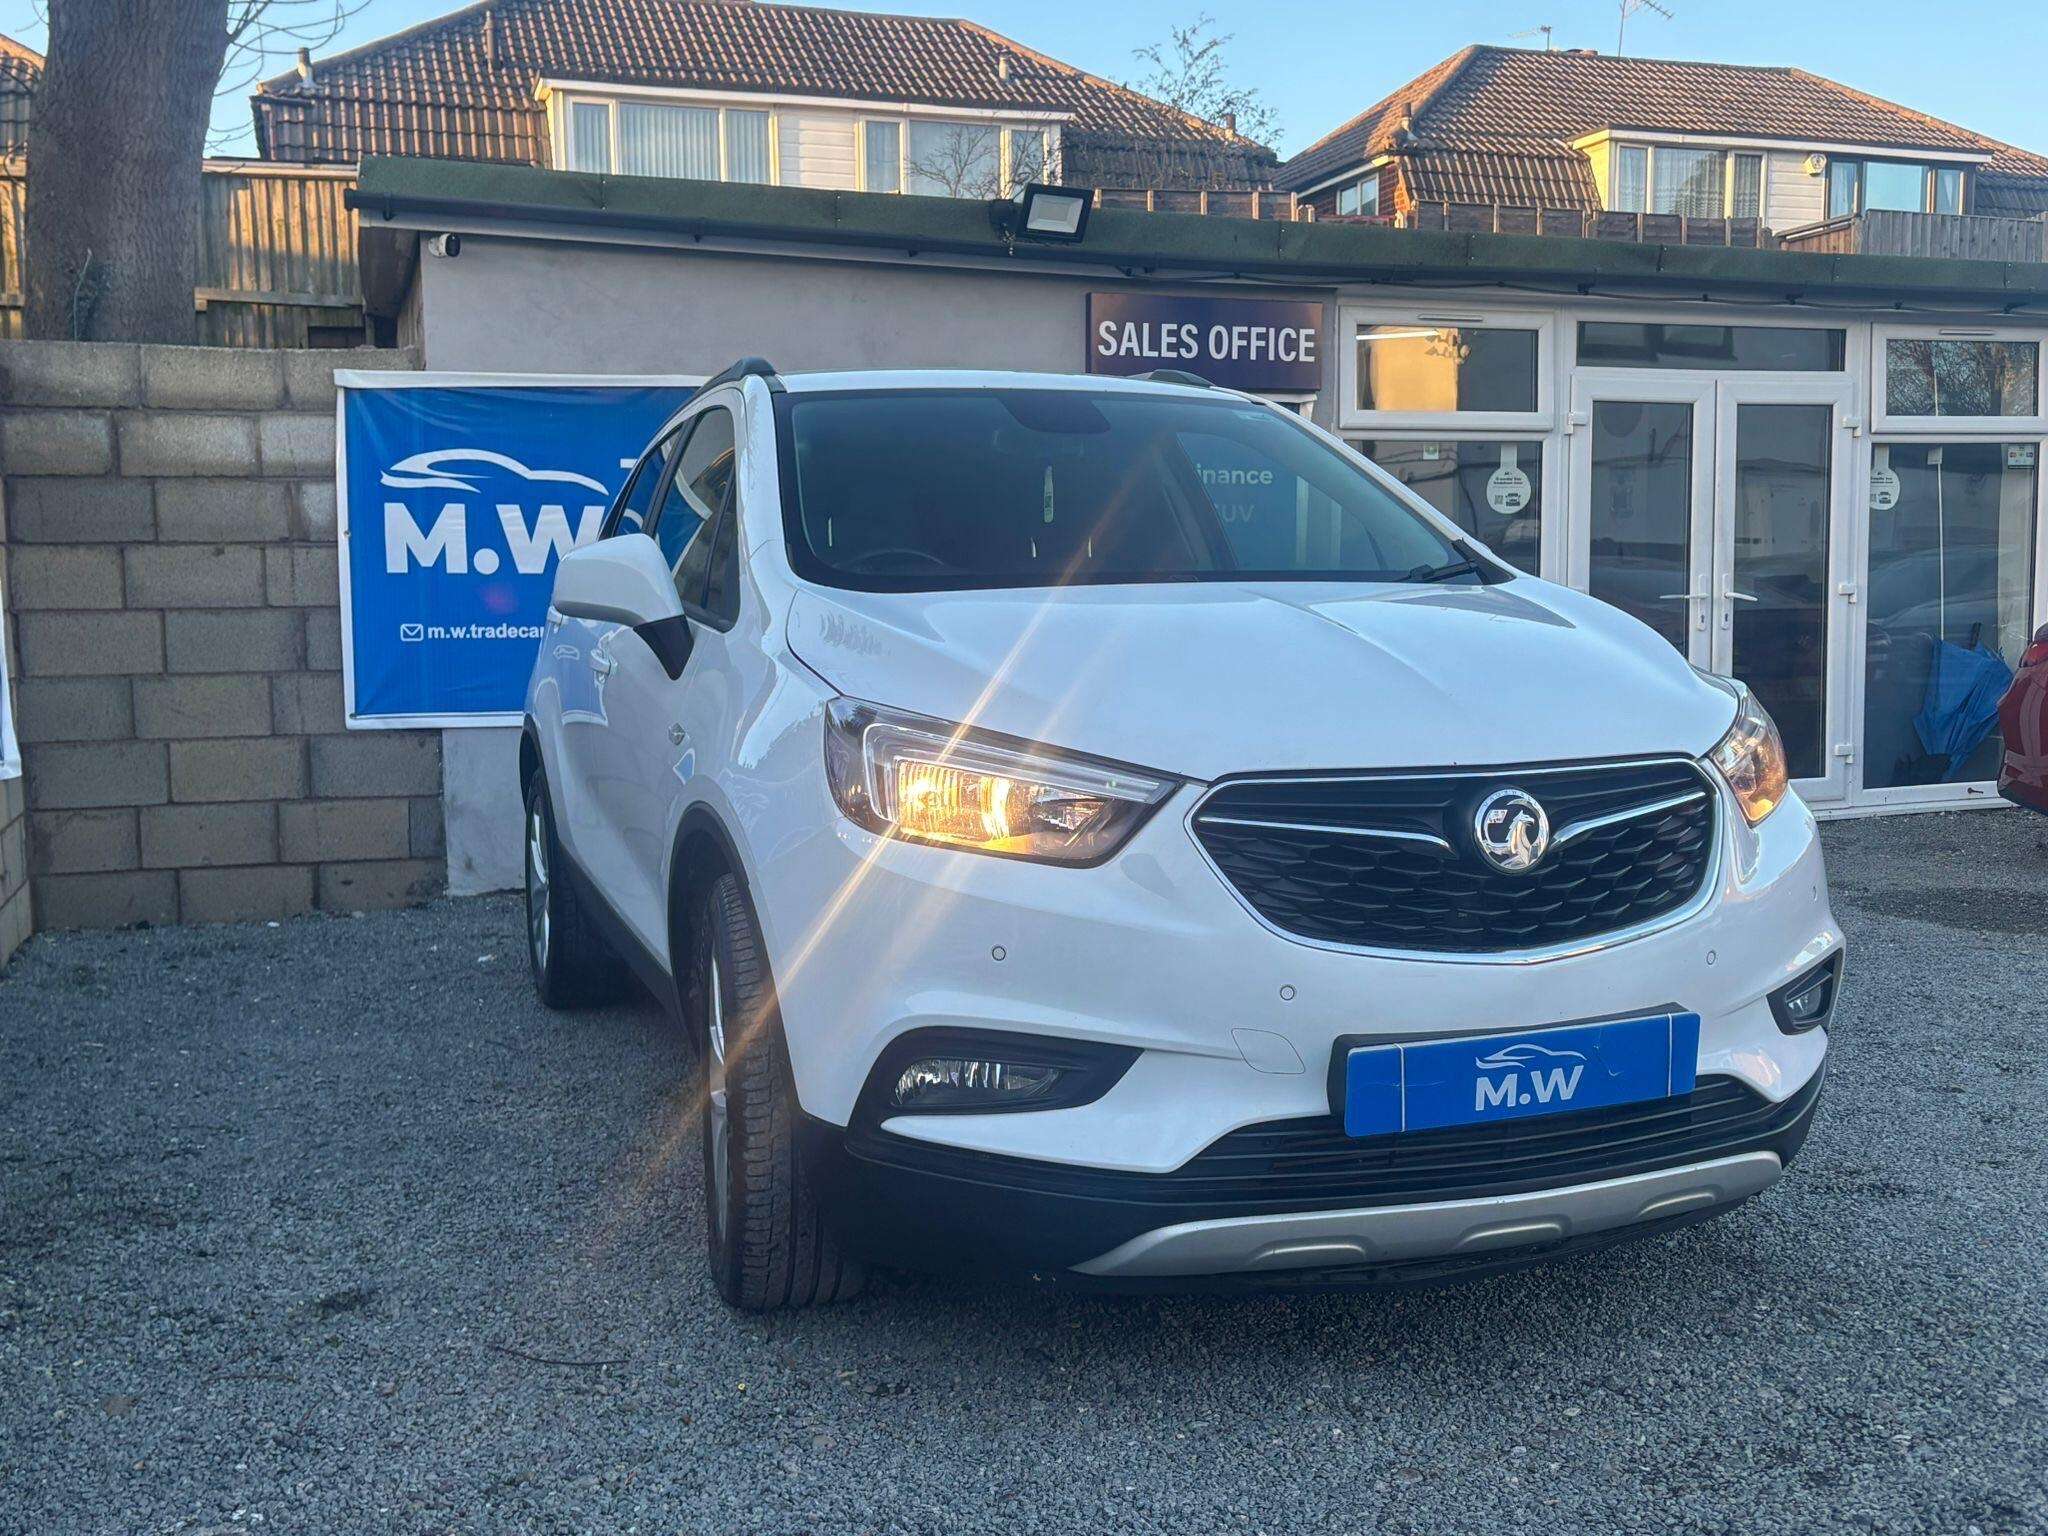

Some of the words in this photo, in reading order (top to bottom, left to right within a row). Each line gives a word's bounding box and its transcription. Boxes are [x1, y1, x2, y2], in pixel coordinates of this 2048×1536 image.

[1098, 320, 1199, 360] SALES
[1208, 324, 1316, 362] OFFICE
[383, 502, 606, 575] M.W
[1475, 1065, 1584, 1111] M.W
